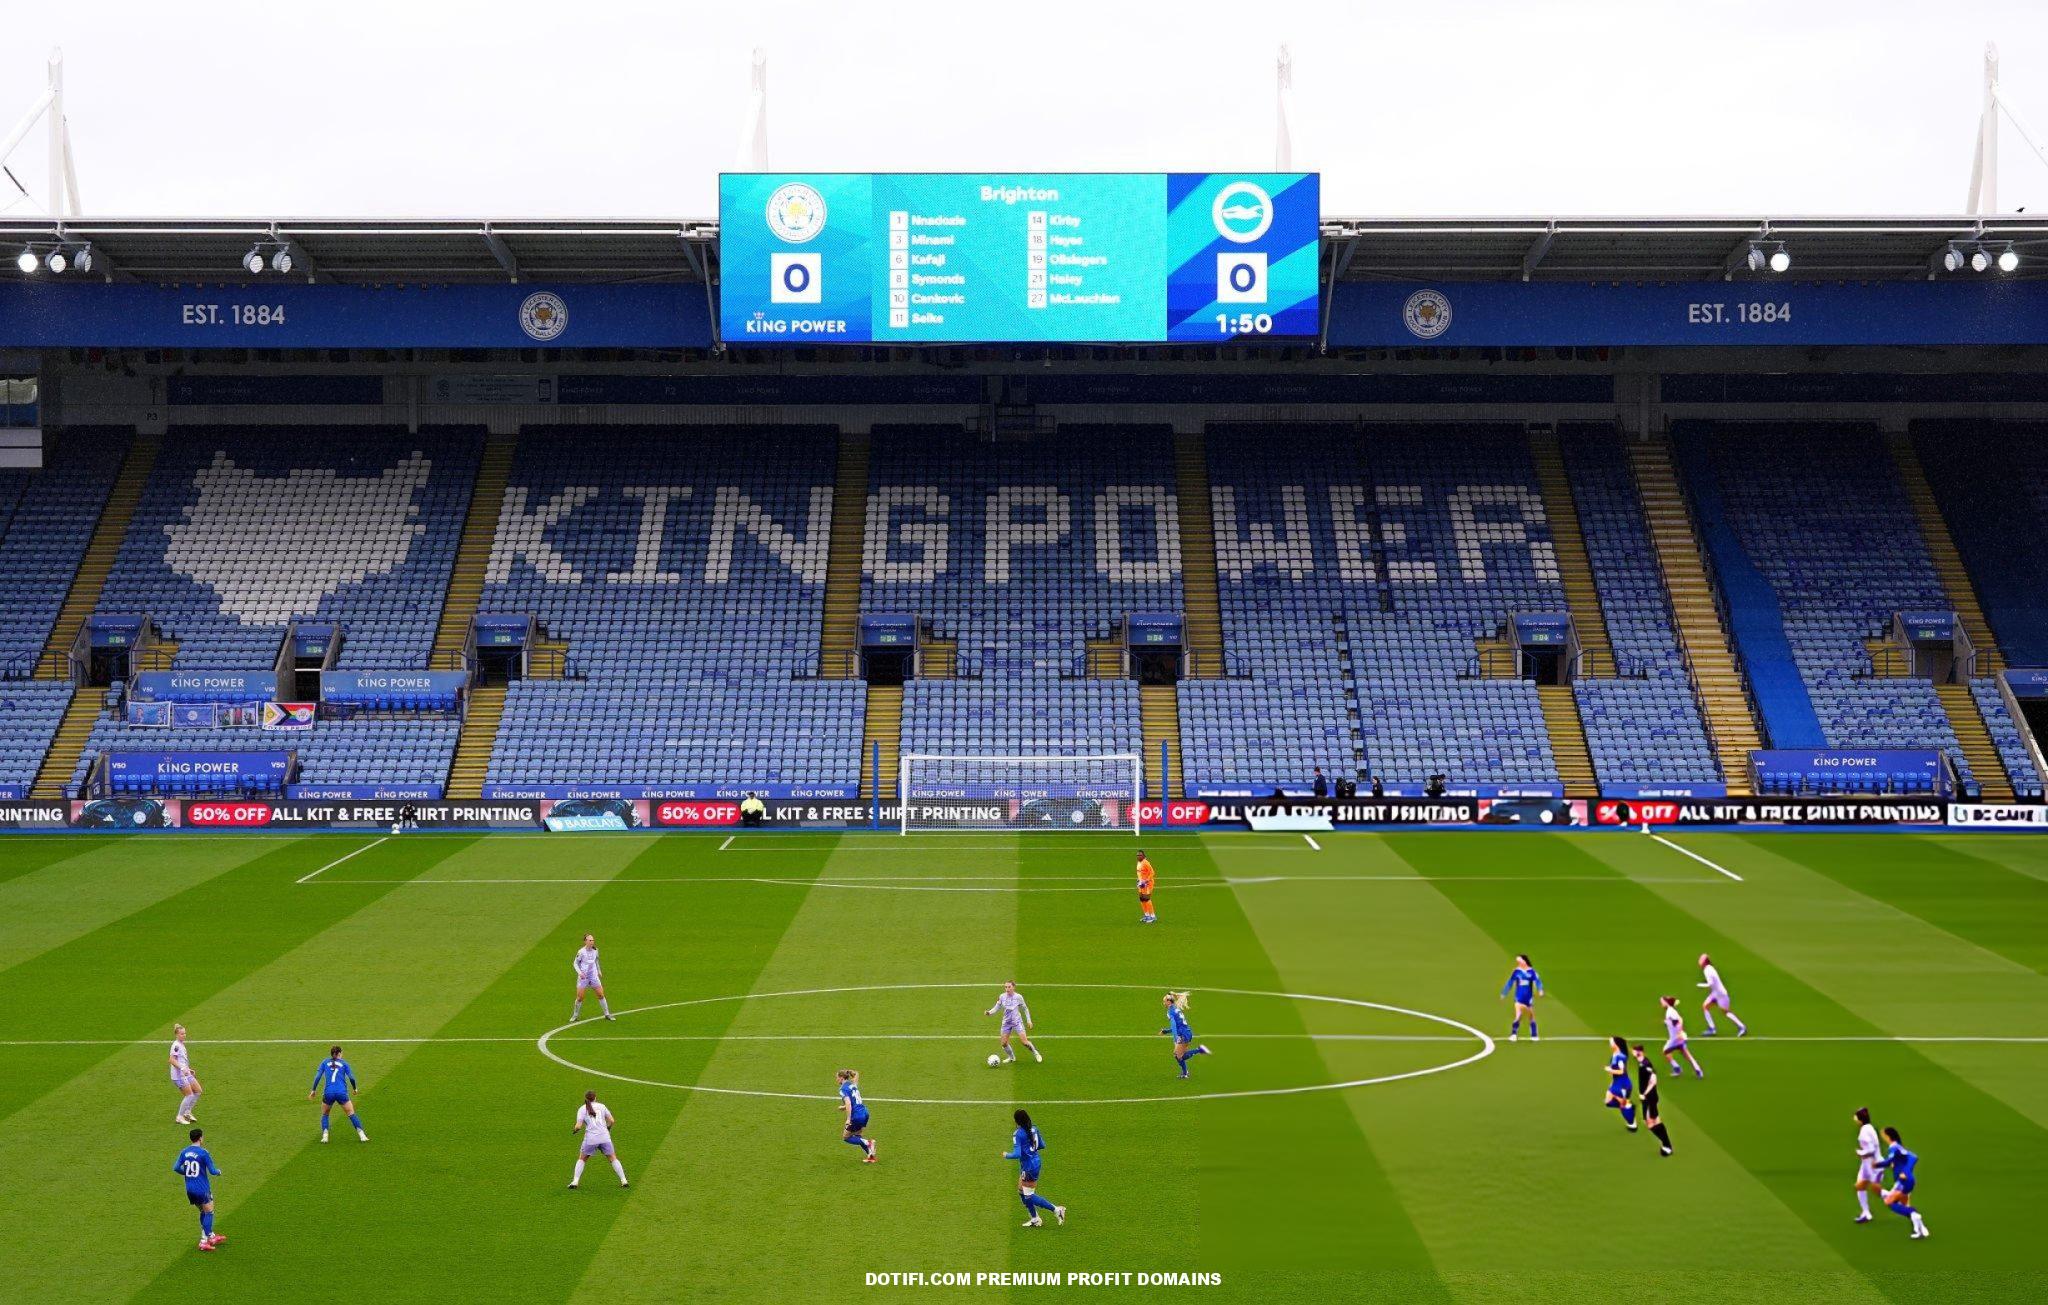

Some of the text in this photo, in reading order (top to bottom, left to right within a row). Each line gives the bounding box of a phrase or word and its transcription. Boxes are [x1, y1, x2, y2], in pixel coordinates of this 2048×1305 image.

[980, 185, 1059, 205] Brighton
[182, 304, 285, 325] EST. 1884
[1688, 303, 1791, 324] EST. 1884
[746, 317, 847, 333] KING POWER
[1216, 313, 1273, 333] 1:50
[171, 678, 245, 688] KING POWER
[357, 678, 431, 688] KING POWER
[1813, 758, 1877, 766] KING POWER
[158, 762, 239, 773] KING POWER
[298, 790, 352, 799] KING POWER
[374, 790, 428, 799] KING POWER
[492, 790, 546, 799] KING POWER
[567, 790, 621, 799] KING POWER
[641, 790, 696, 798] KING POWER
[716, 790, 739, 798] KING
[791, 790, 845, 798] KING POWER
[912, 789, 966, 798] KING POWER
[994, 790, 1017, 798] KING
[1076, 789, 1130, 798] KING POWER
[193, 808, 230, 821] 50%
[234, 808, 267, 821] OFF
[270, 808, 303, 821] ALL
[307, 807, 334, 821] KIT
[336, 807, 352, 821] &
[353, 807, 395, 821] FREE
[453, 807, 533, 821] PRINTING
[661, 807, 699, 820] 50%
[703, 807, 736, 820] OFF
[776, 807, 803, 820] KIT
[806, 807, 819, 820] &
[825, 807, 864, 820] FREE
[922, 806, 1001, 820] PRINTING
[1171, 806, 1202, 820] OFF
[565, 818, 623, 828] BARCLAYS
[330, 1067, 339, 1083] 7
[184, 1160, 200, 1178] 29
